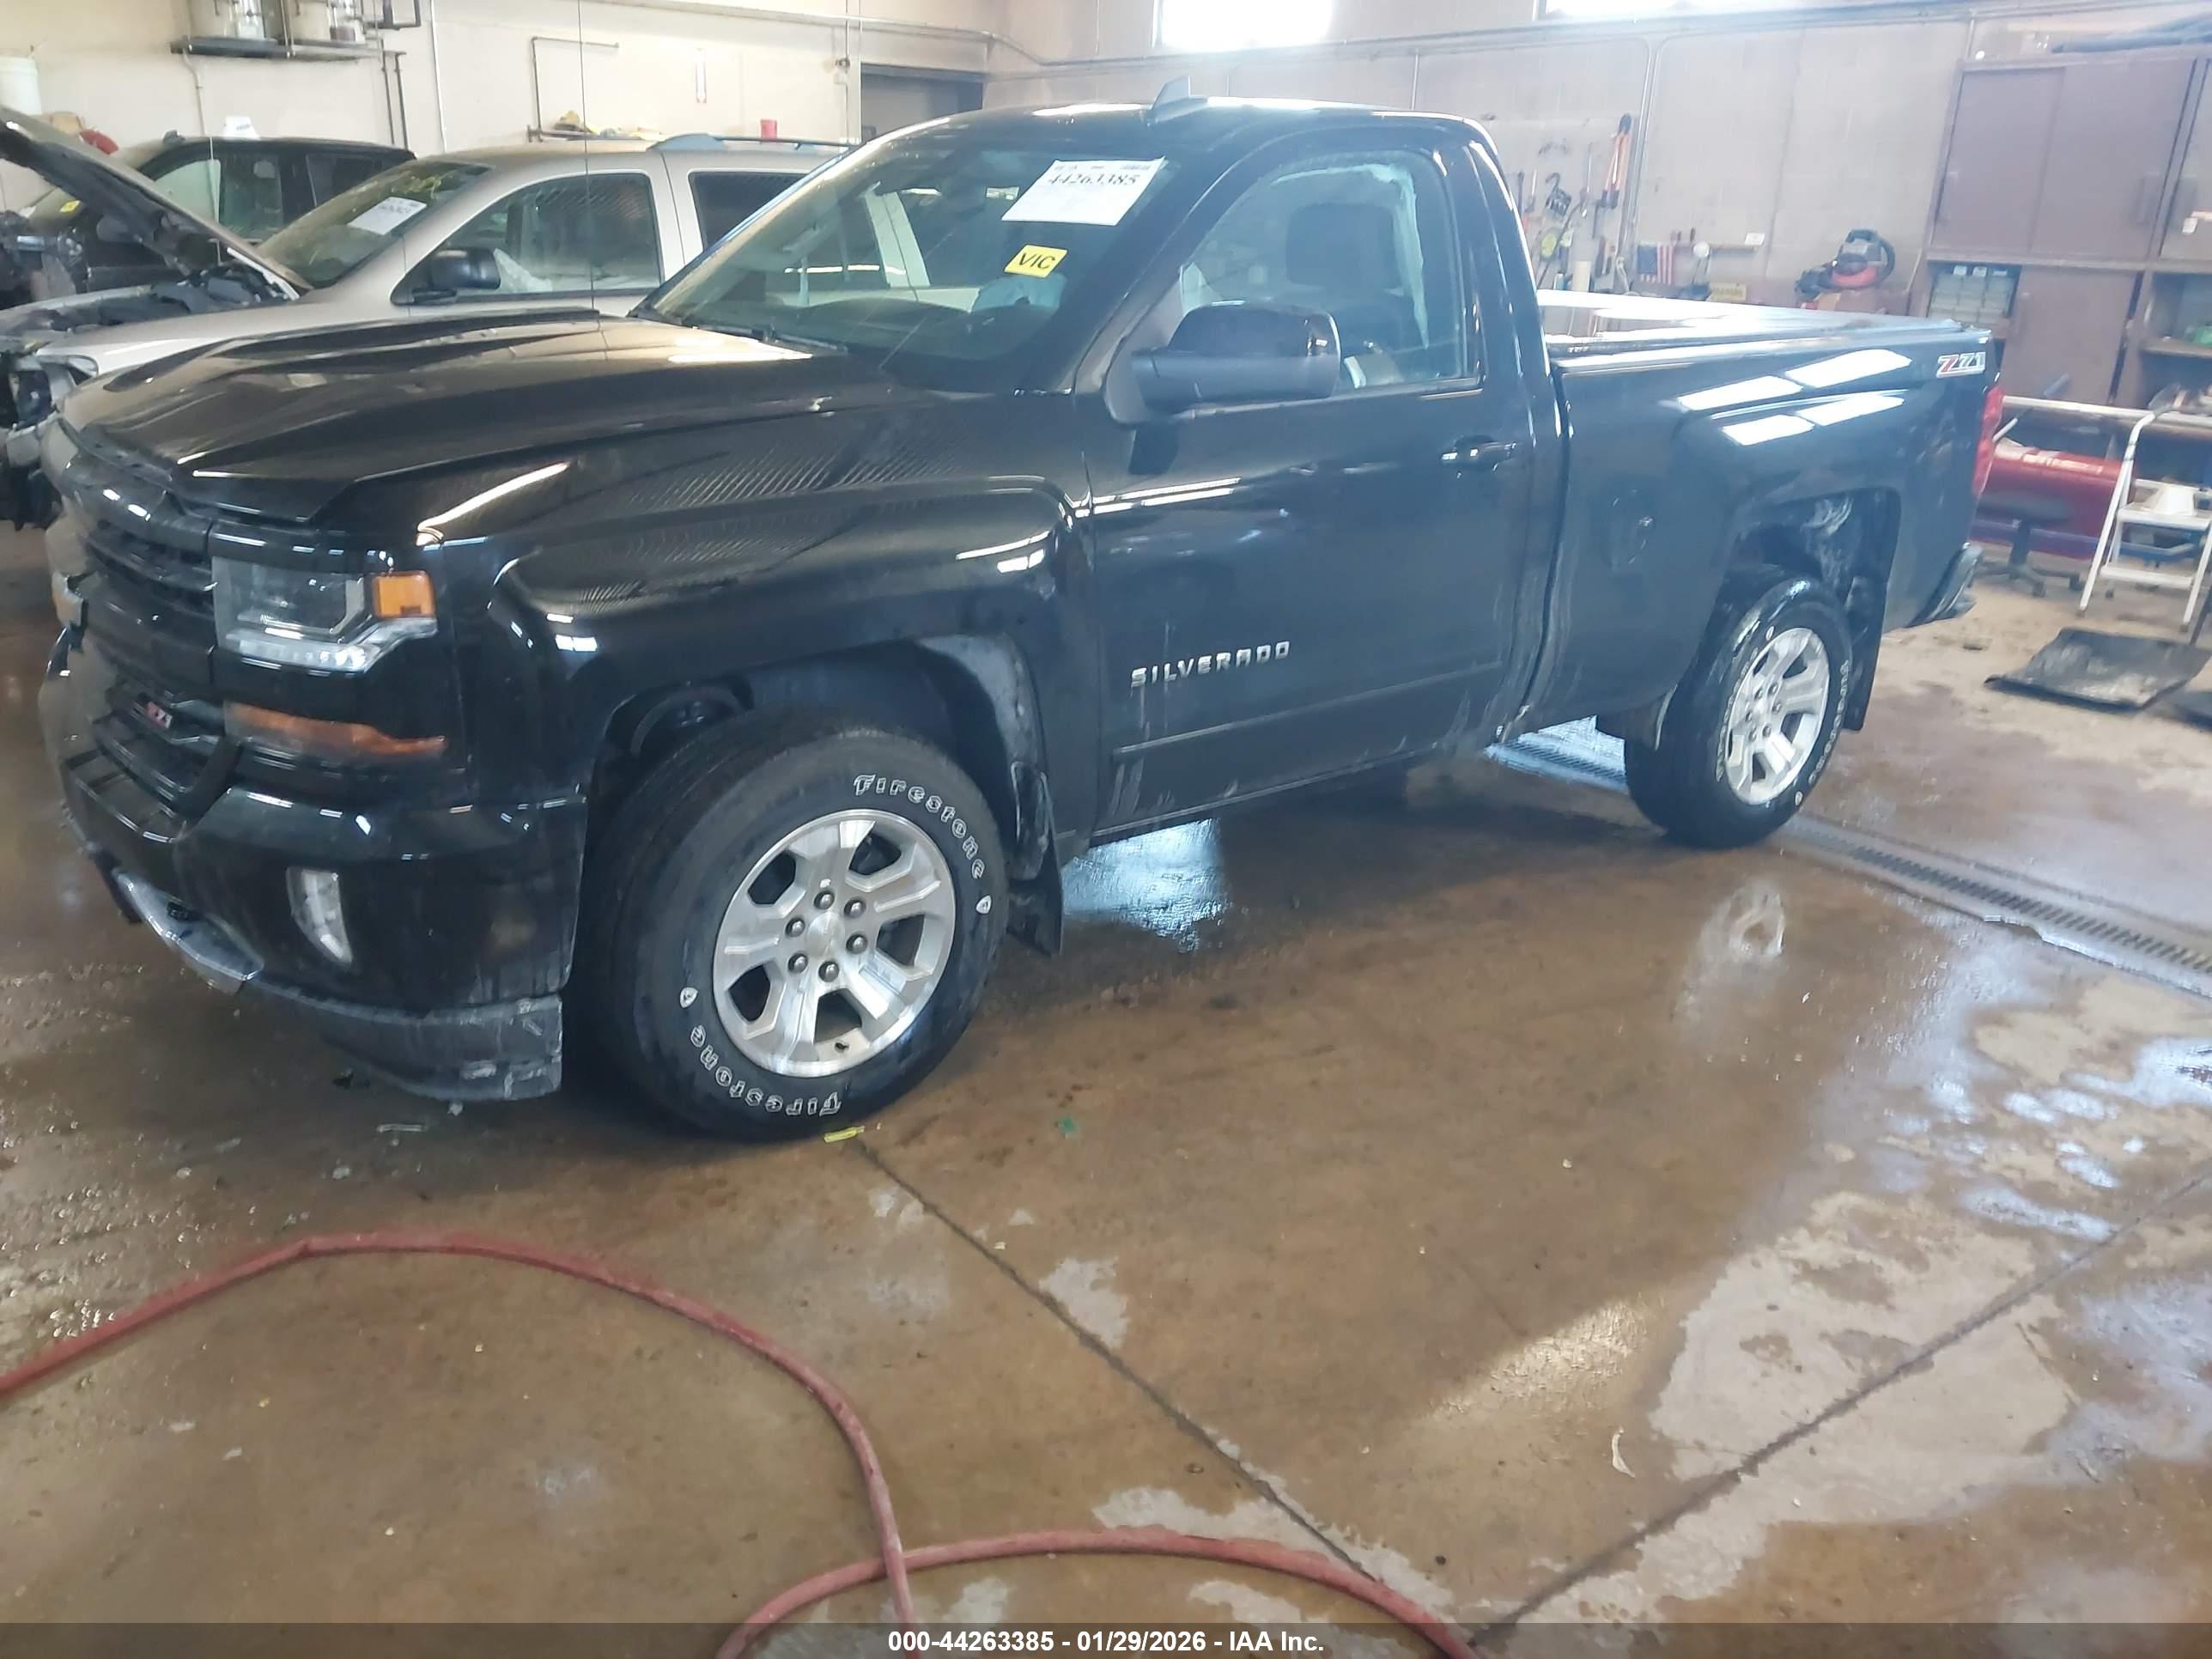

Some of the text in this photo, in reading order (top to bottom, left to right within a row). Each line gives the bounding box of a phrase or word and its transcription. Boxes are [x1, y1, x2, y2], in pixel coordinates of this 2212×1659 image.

[1018, 252, 1056, 270] VIC
[1936, 351, 1986, 379] Z71
[1130, 640, 1291, 688] SILVERADO
[853, 773, 986, 880] Firestone
[690, 1024, 842, 1117] Firestone
